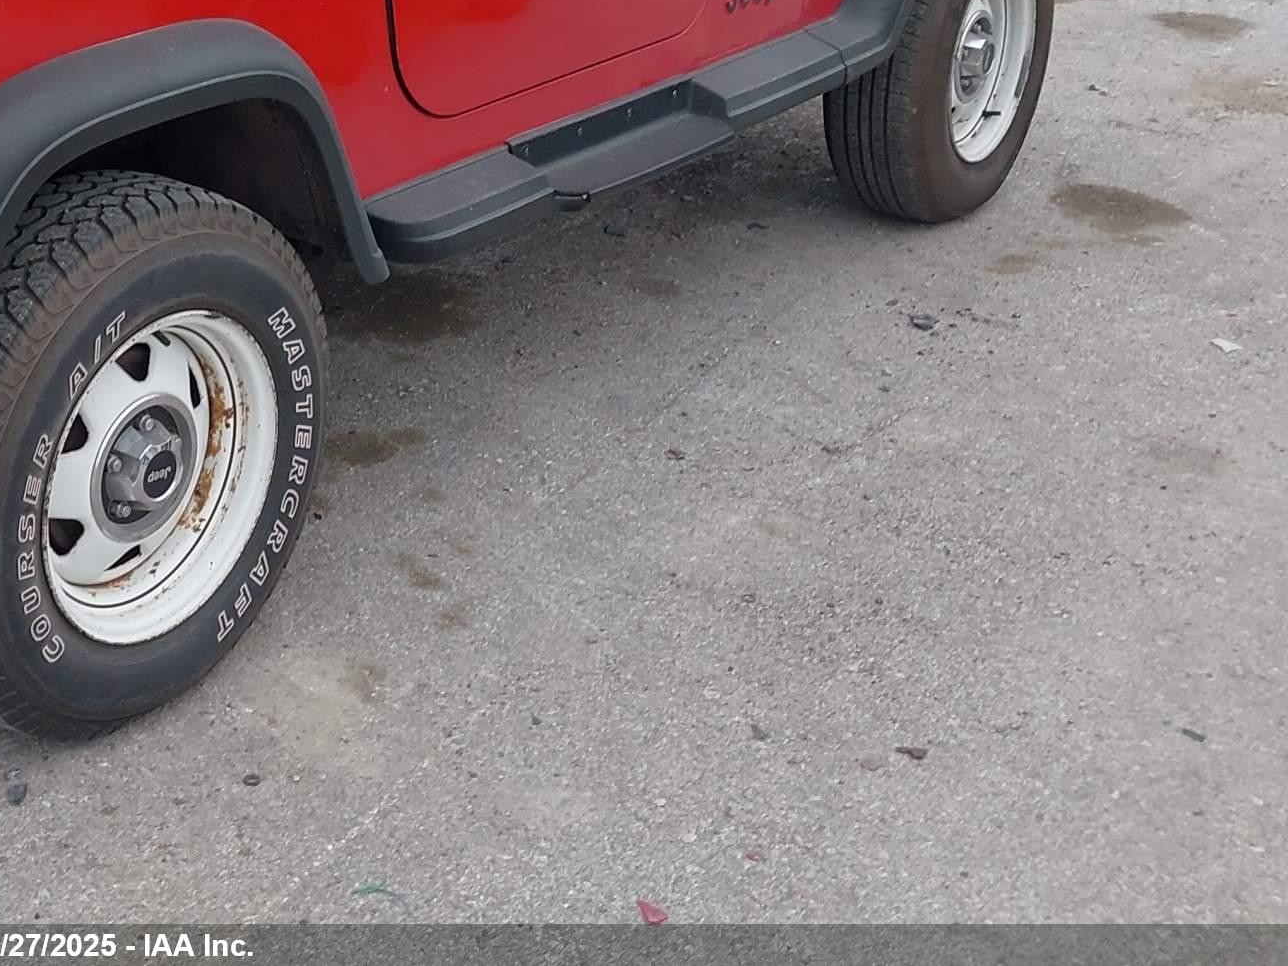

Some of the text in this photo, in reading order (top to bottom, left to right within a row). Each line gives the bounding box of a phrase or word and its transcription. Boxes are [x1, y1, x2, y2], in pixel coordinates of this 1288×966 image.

[16, 310, 127, 665] COURSER A/T
[146, 465, 173, 484] Jeep
[215, 305, 314, 643] MASTERCRAFT
